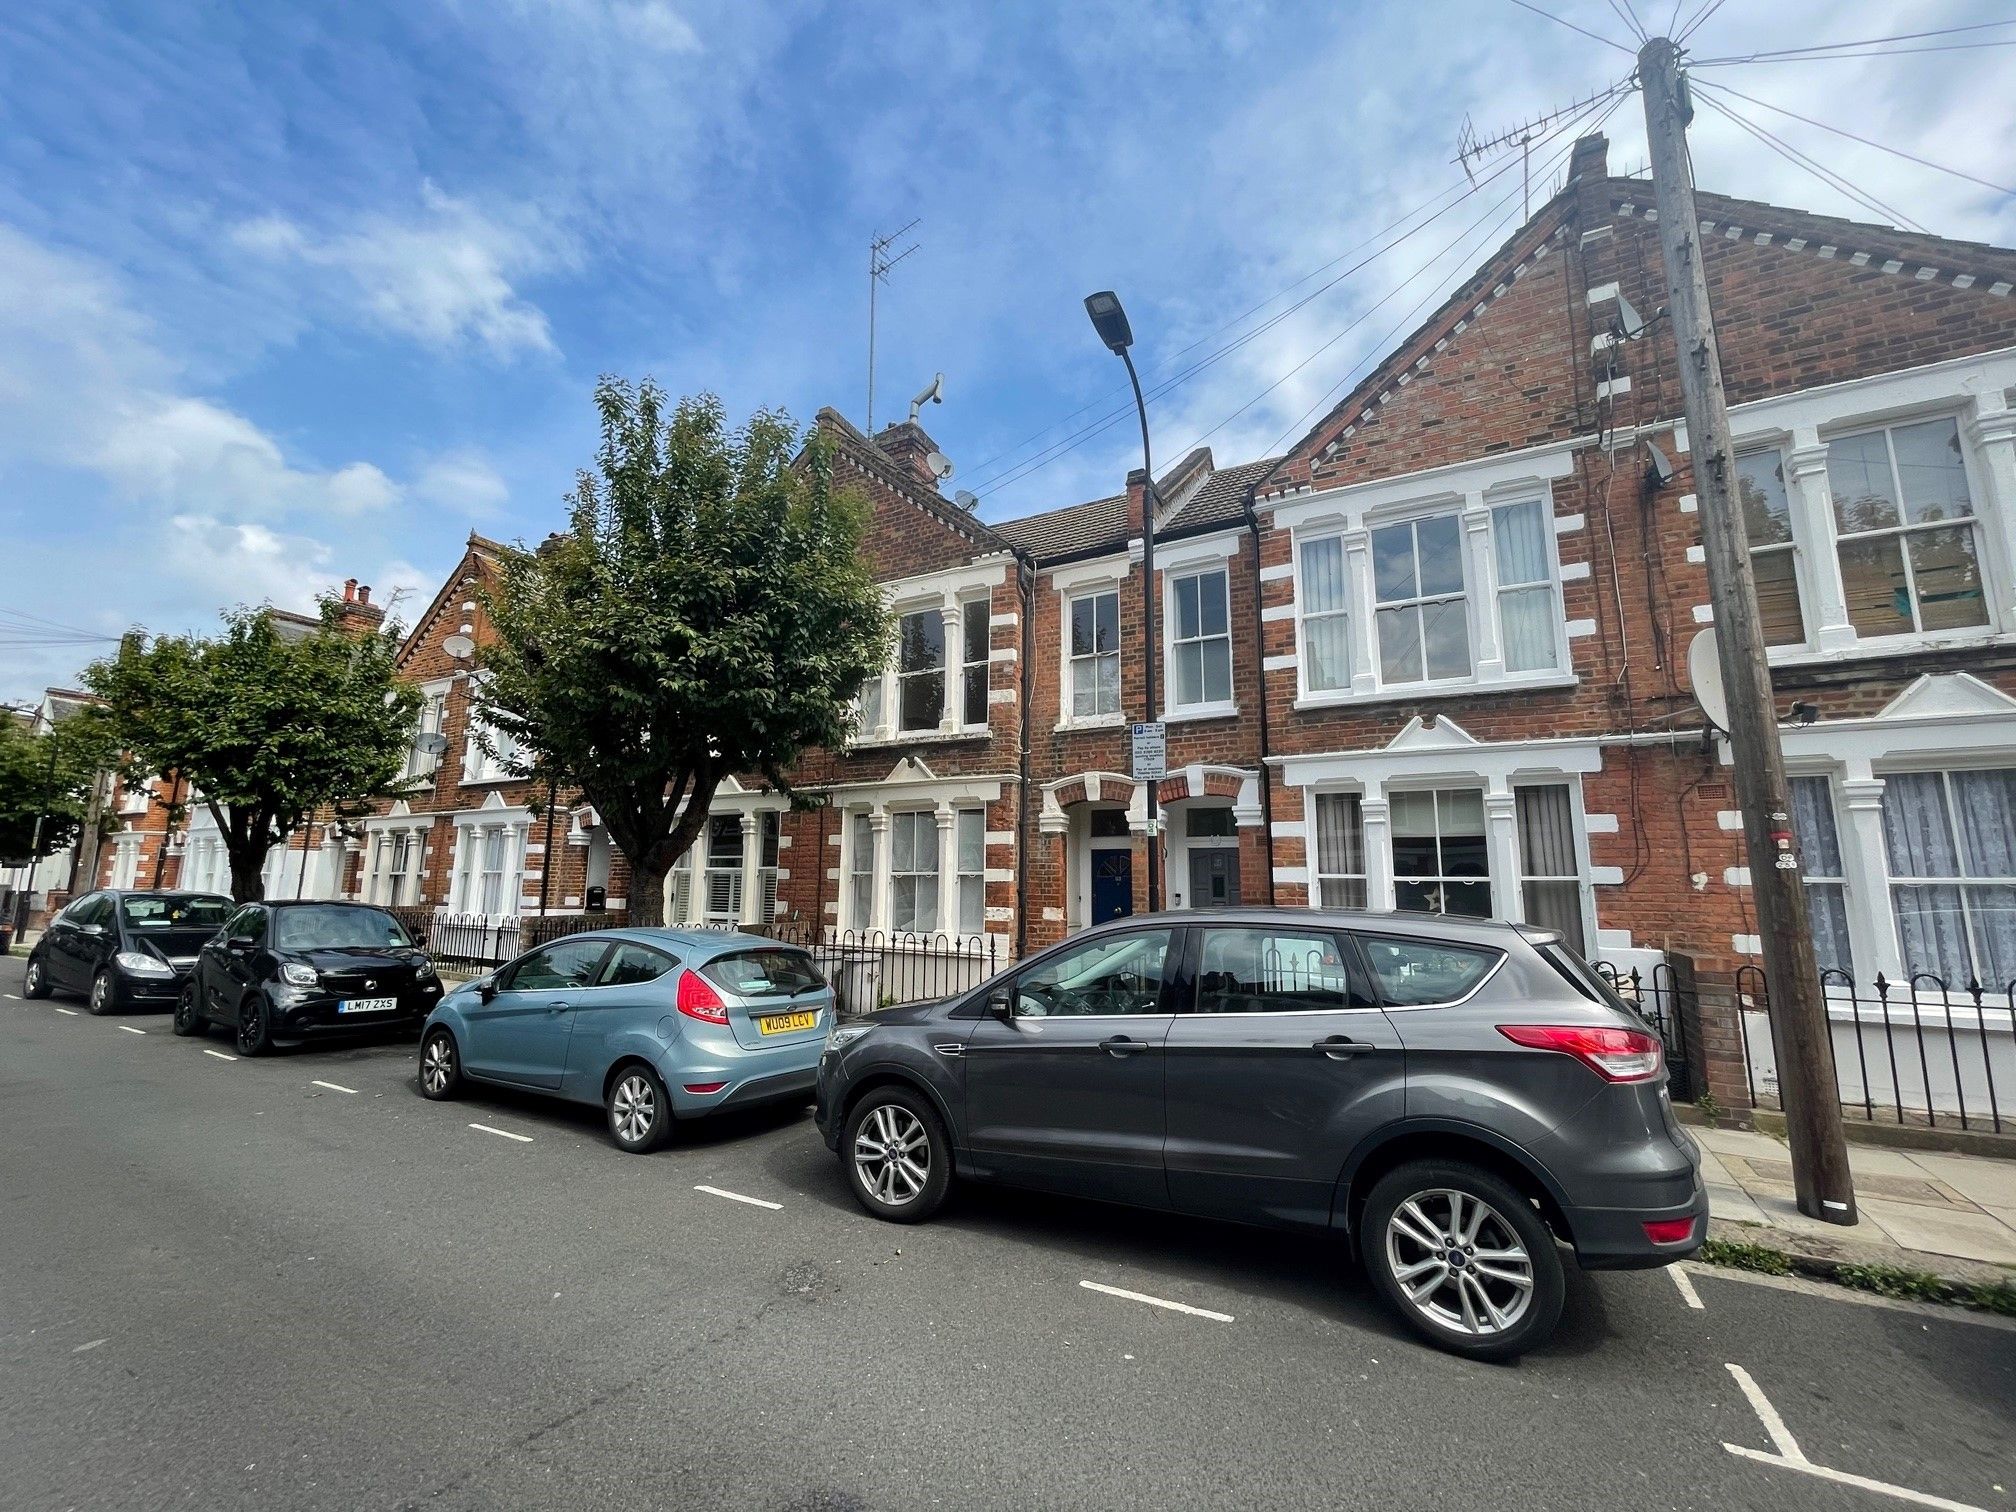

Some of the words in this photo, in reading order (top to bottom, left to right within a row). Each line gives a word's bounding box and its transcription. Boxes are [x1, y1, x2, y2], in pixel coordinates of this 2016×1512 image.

[347, 1001, 371, 1010] LM17
[373, 999, 393, 1008] ZXS
[765, 1017, 791, 1031] WU09
[792, 1014, 810, 1027] LCV
